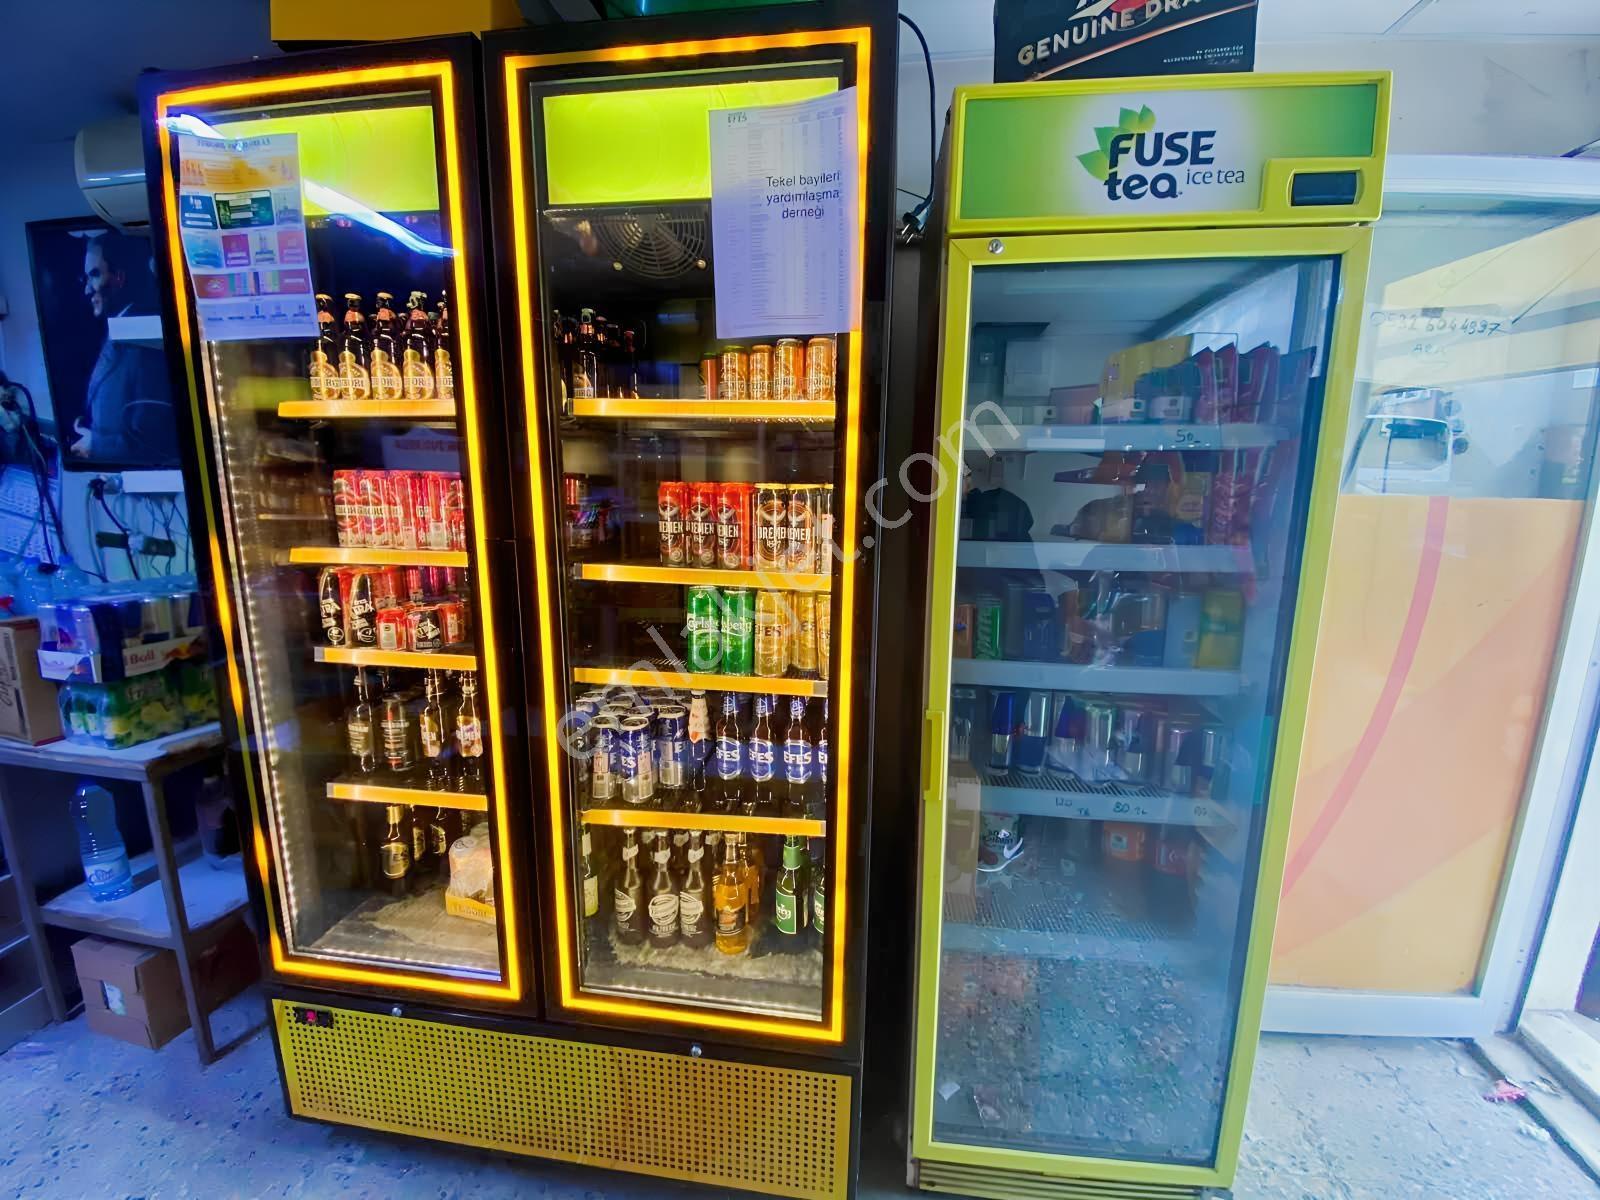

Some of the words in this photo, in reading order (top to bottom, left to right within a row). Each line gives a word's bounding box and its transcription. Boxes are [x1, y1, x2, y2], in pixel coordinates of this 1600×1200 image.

[1018, 10, 1135, 66] GENUINE
[1108, 130, 1217, 168] FUSE
[765, 175, 797, 188] Tekel
[1186, 168, 1214, 185] ice
[1217, 168, 1245, 184] tea
[1103, 171, 1179, 200] tea
[766, 189, 840, 207] yardımlaşma
[782, 206, 825, 220] derneği
[783, 750, 812, 764] EFES
